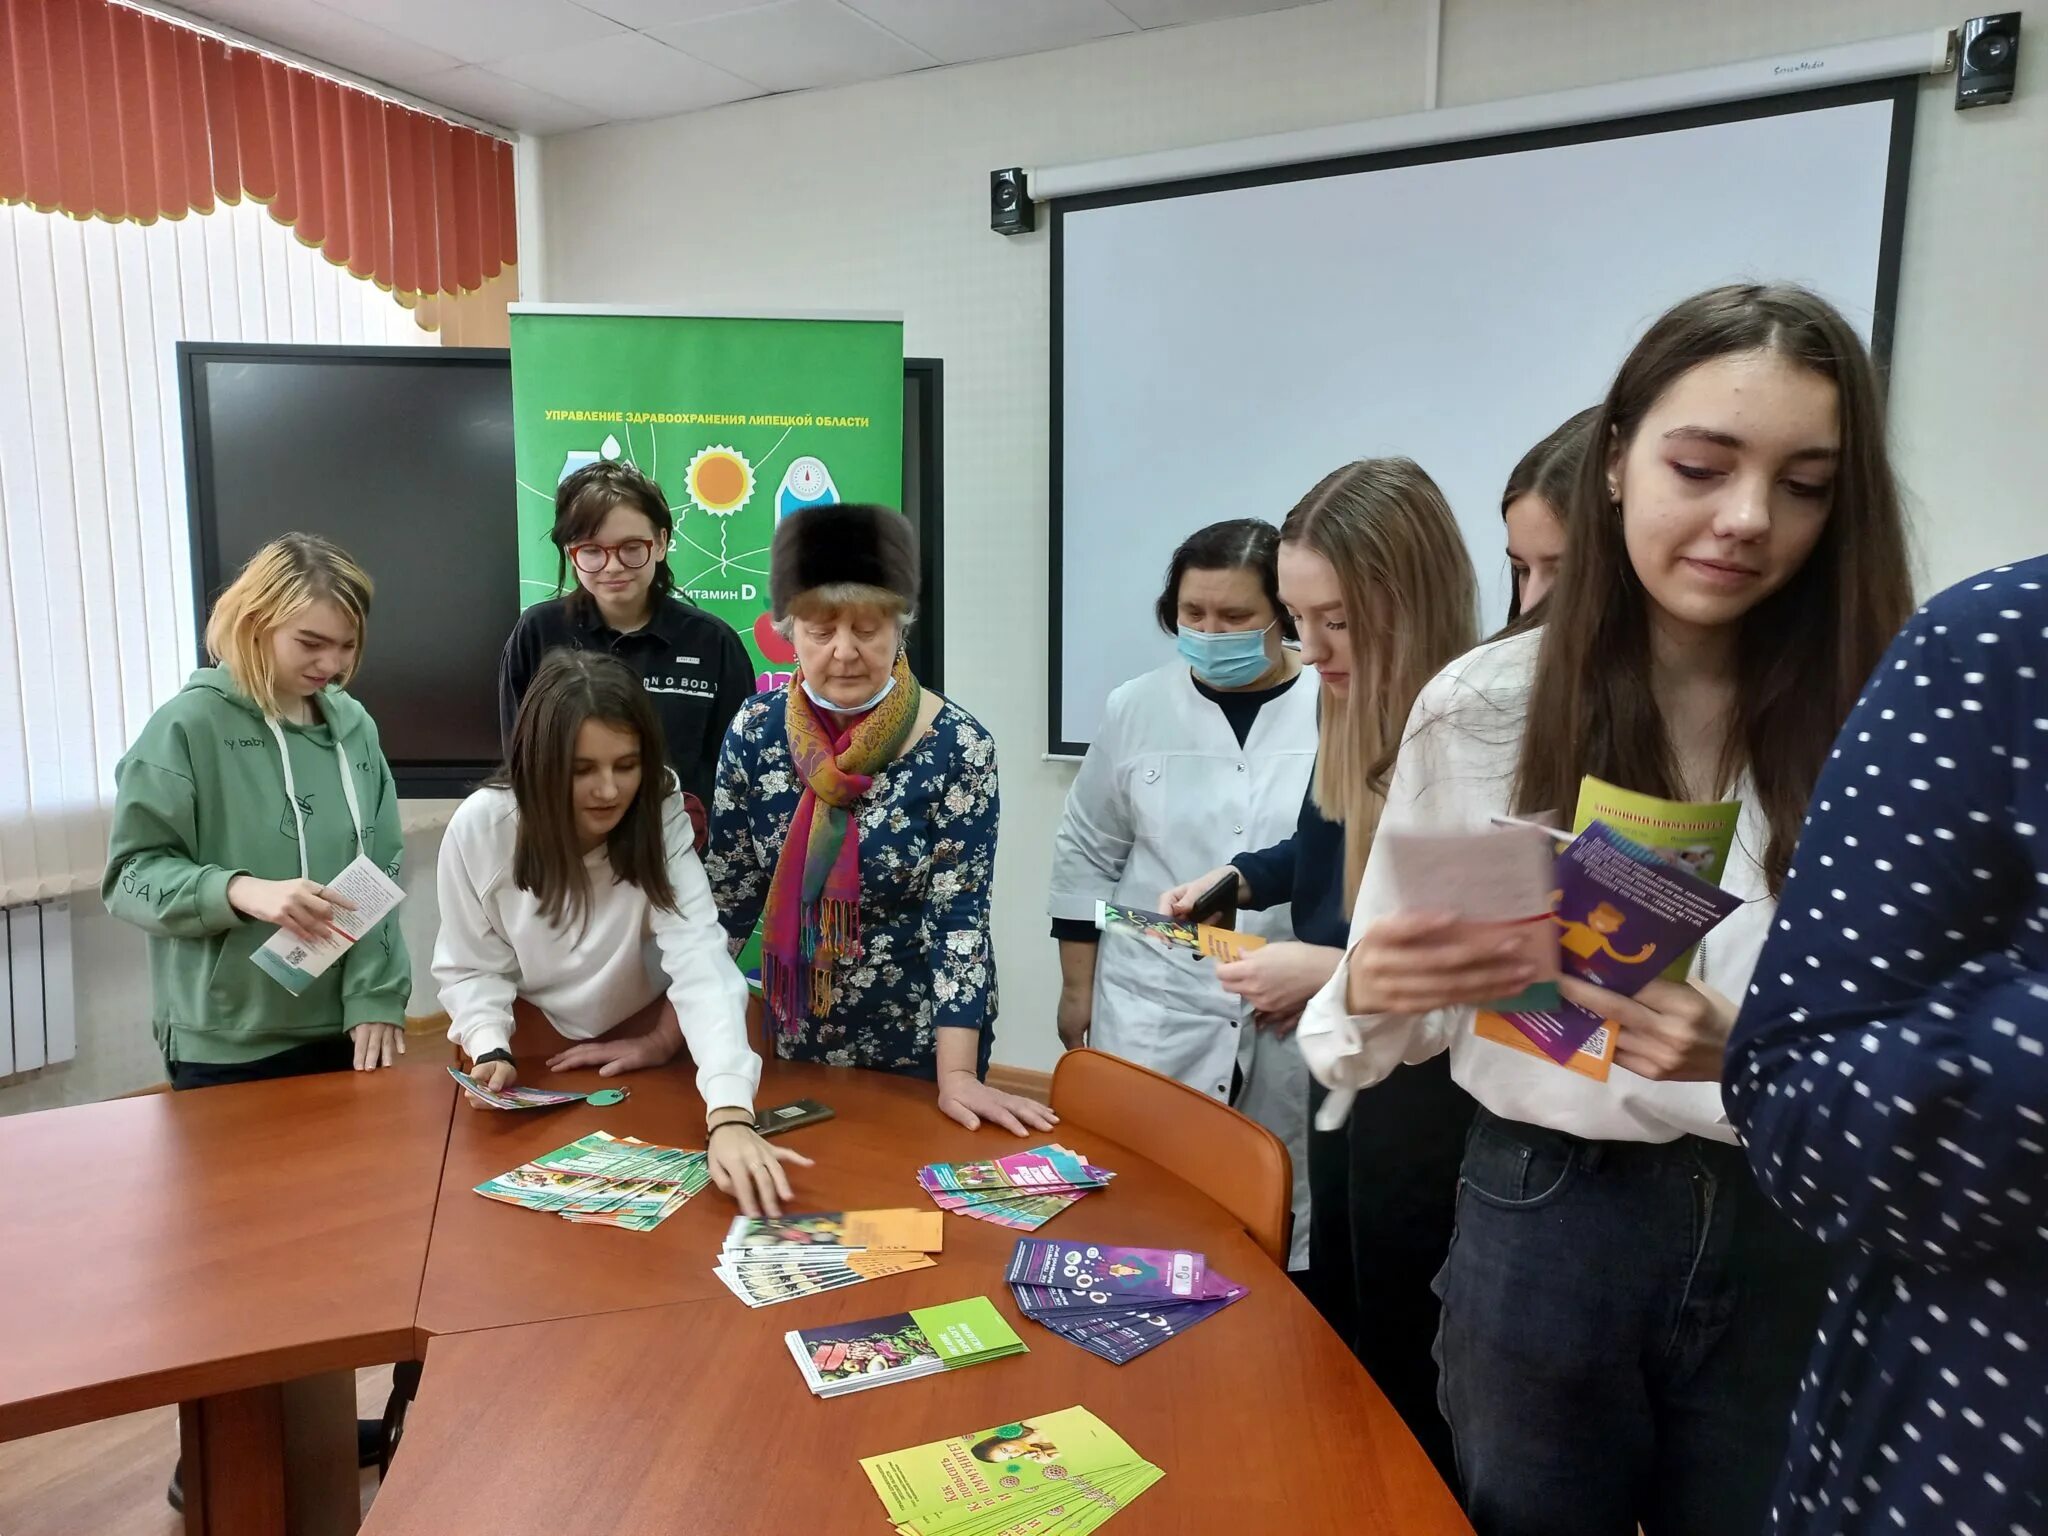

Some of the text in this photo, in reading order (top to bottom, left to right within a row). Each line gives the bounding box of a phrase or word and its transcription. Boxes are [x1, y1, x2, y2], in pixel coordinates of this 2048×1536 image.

[544, 410, 869, 427] УПРАВЛЕНИЕ ЗДРАВООХРАНЕНИЯ ЛИПЕЦКОЙ ОБЛАСТИ
[741, 584, 757, 600] D
[946, 1442, 991, 1494] ИММУНИТЕТ
[941, 1484, 959, 1503] Как
